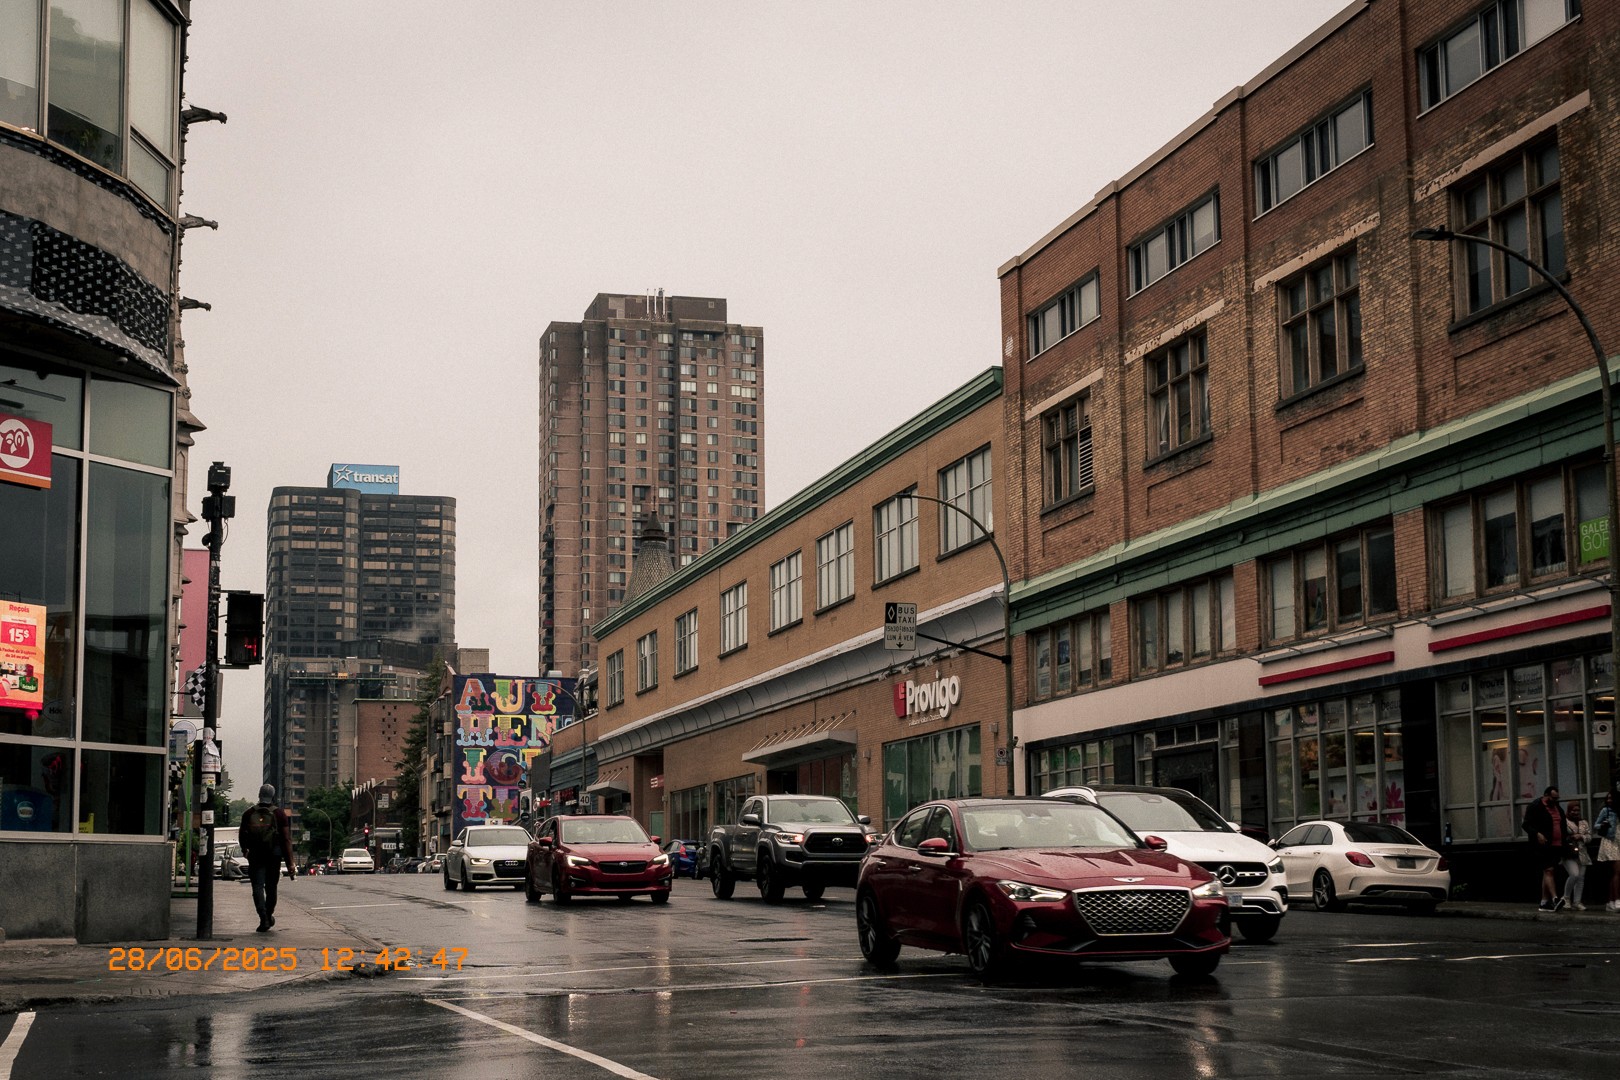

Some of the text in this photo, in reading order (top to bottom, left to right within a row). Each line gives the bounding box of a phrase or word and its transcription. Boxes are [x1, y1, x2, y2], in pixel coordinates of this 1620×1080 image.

[353, 471, 399, 484] transat
[9, 604, 30, 613] Reçois
[897, 606, 915, 615] BUS
[897, 616, 915, 624] TAXI
[9, 627, 30, 643] 15$
[455, 678, 562, 715] AUT
[906, 669, 960, 718] Provigo
[580, 795, 590, 804] 40
